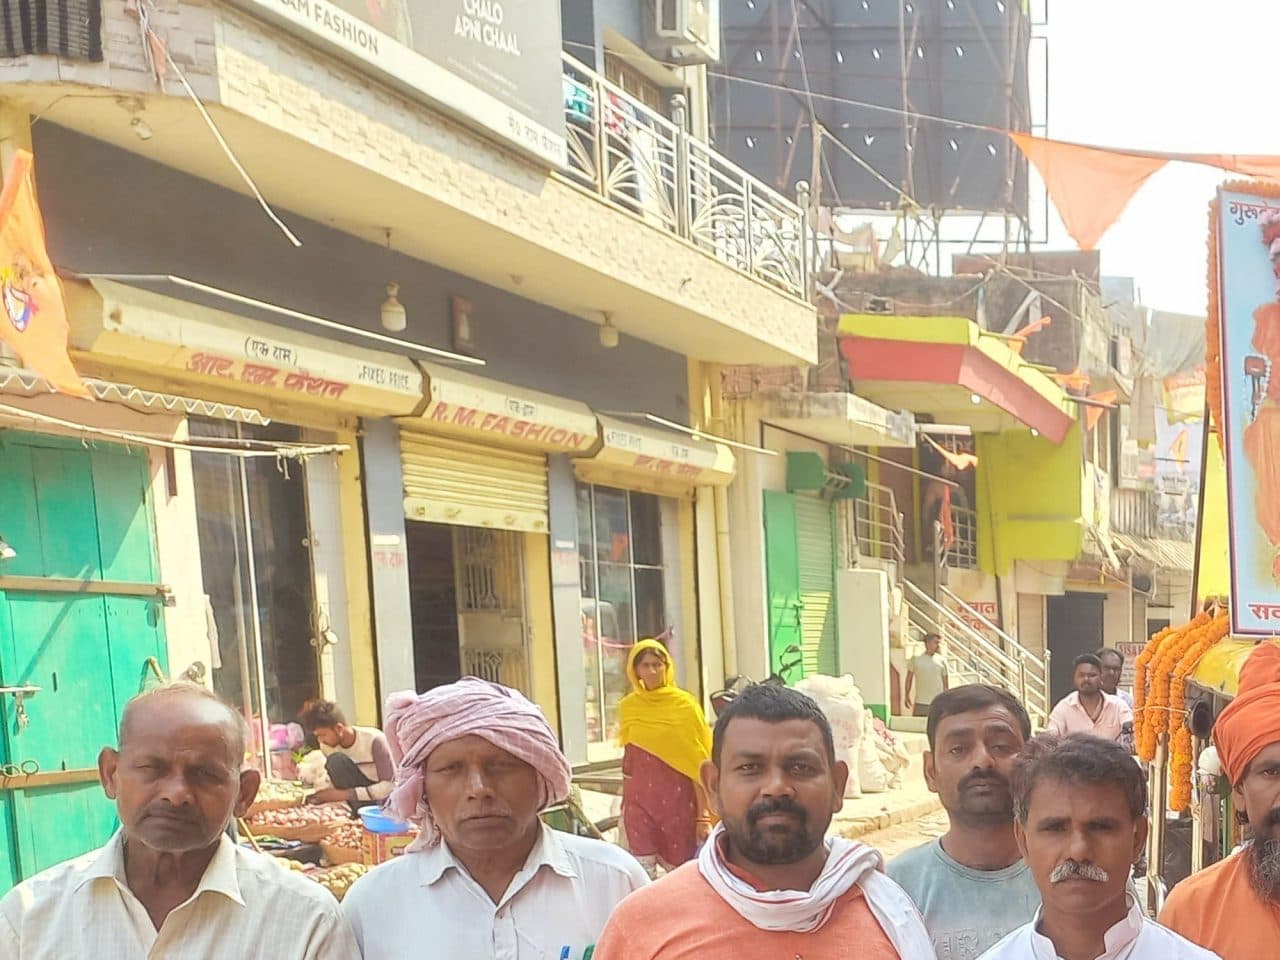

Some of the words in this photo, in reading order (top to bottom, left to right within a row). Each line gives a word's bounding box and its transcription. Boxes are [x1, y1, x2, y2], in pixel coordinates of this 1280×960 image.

[313, 3, 379, 55] FASHION
[431, 401, 448, 422] R.
[452, 406, 477, 427] M.
[479, 412, 587, 449] FASHION
